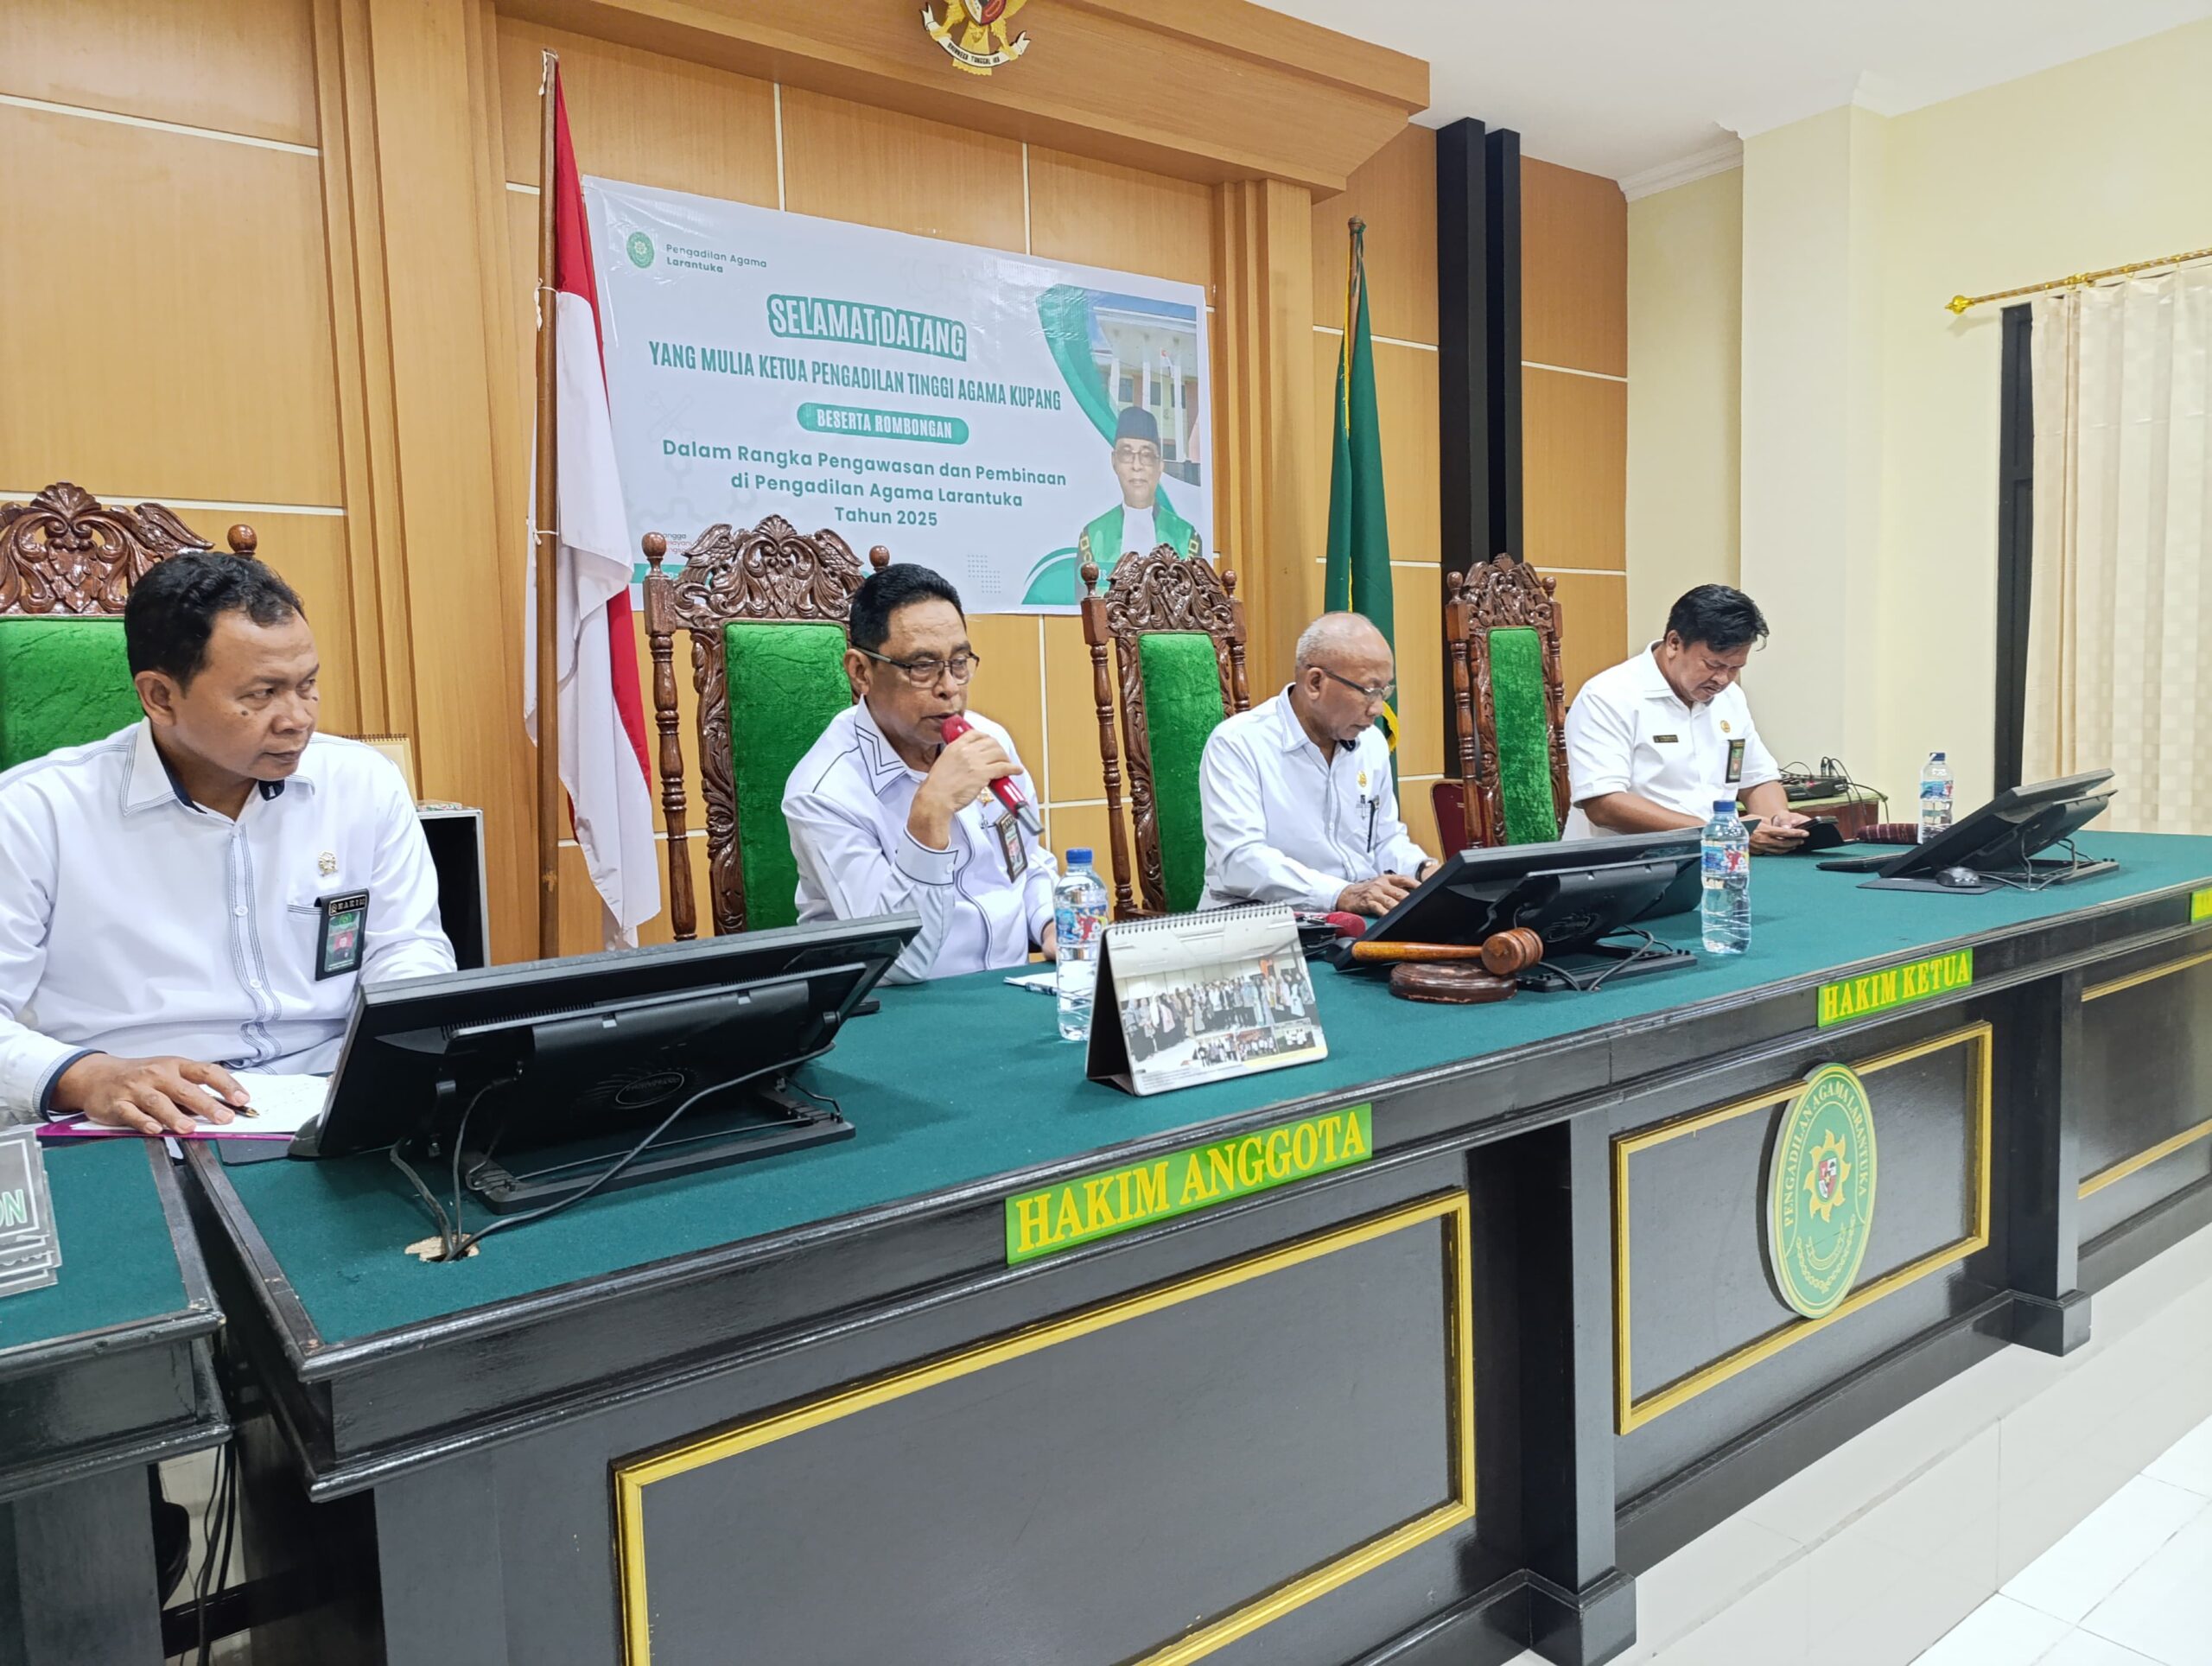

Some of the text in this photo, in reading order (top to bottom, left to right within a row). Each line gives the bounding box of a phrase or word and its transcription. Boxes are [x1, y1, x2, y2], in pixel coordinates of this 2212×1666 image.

[666, 244, 767, 268] Pengadilan Agama
[667, 257, 723, 273] Larantuka
[771, 298, 964, 357] SELAMAT DATANG
[649, 340, 1061, 410] YANG MULIA KETUA PENGADILAN TINGGI AGAMA KUPANG
[817, 409, 952, 439] BESERTA ROMBONGAN
[663, 439, 1066, 486] Dalam Rangka Pengawasan dan Pembinaan
[731, 472, 1022, 506] di Pengadilan Agama Larantuka
[835, 506, 938, 526] Tahun 2025
[1823, 952, 1969, 1022] HAKIM KETUA
[1783, 1081, 1869, 1227] PENGADILAN AGAMA LARANTUKA
[1015, 1111, 1365, 1253] HAKIM ANGGOTA
